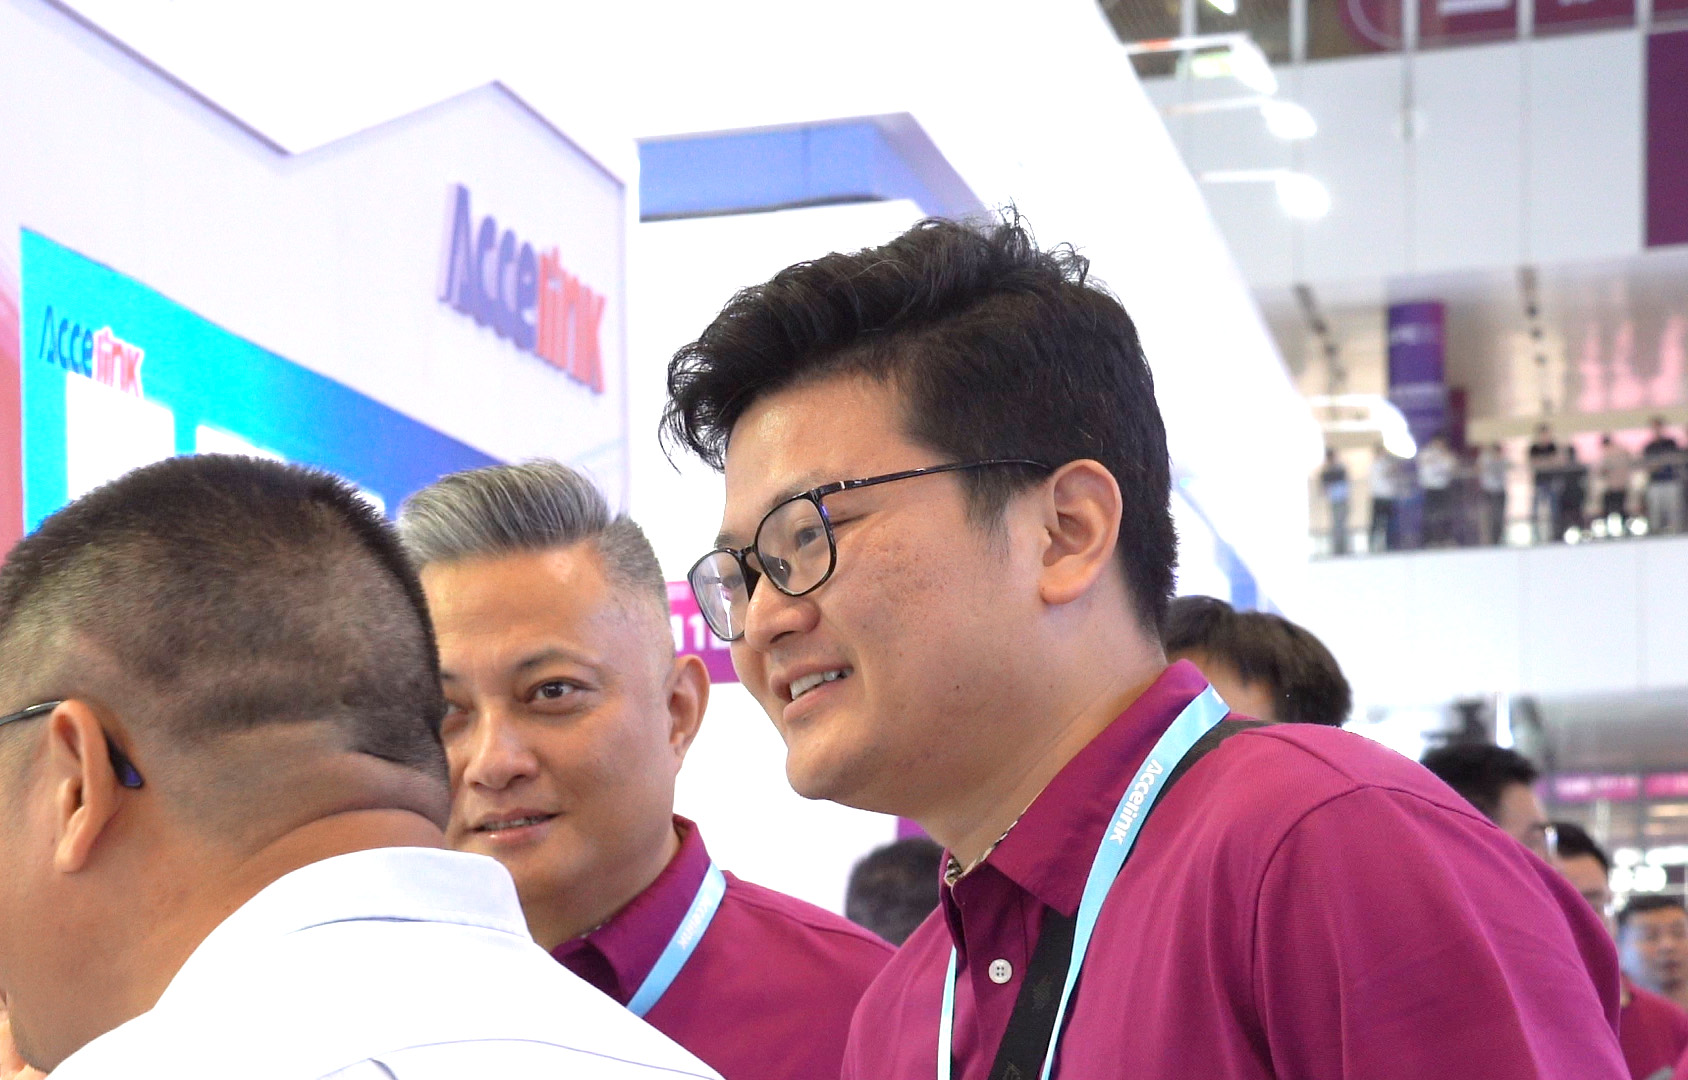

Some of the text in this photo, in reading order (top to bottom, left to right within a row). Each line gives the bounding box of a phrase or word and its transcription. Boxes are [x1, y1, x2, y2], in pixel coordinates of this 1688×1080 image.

[438, 184, 605, 395] Accelink
[38, 304, 142, 398] Accelink
[1110, 758, 1163, 846] Accelink
